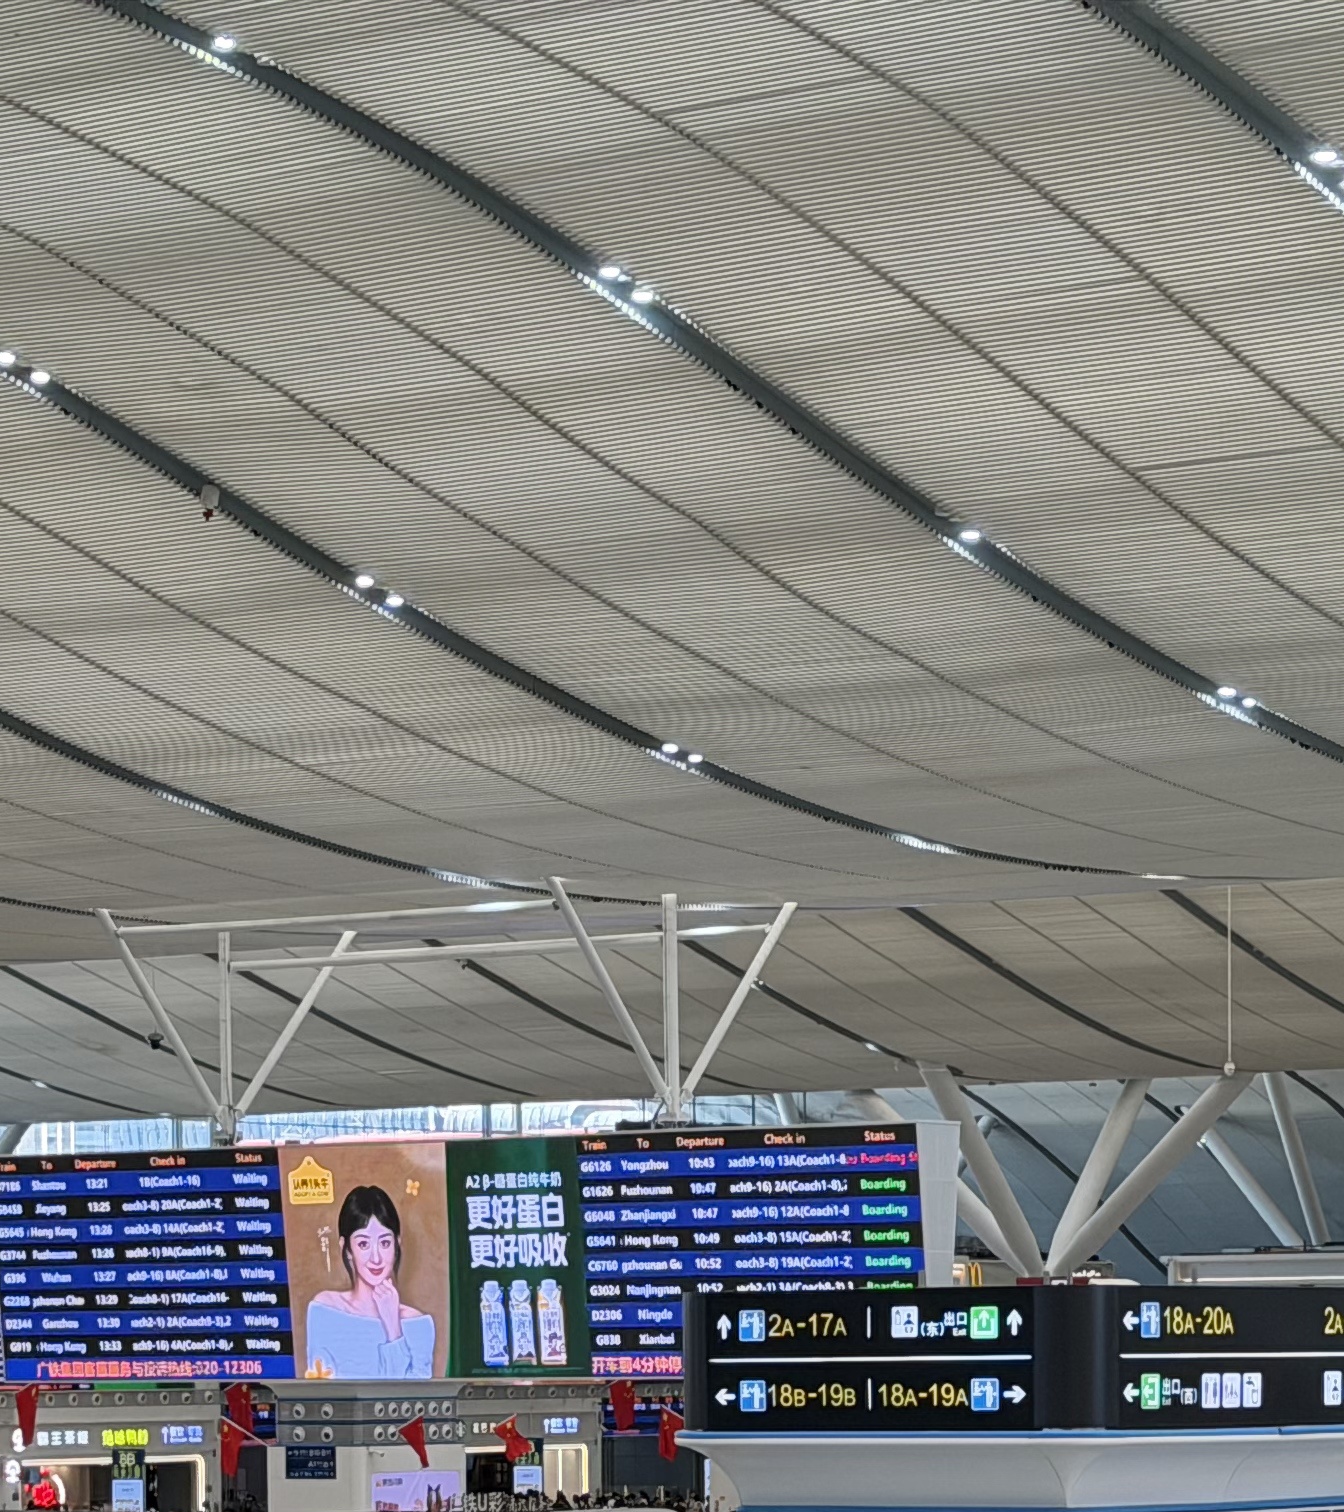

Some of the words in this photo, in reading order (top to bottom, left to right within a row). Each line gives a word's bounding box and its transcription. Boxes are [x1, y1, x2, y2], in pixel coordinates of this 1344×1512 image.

[582, 1140, 607, 1151] Train
[636, 1138, 650, 1149] To
[676, 1137, 725, 1149] Departure
[764, 1134, 794, 1145] Check
[796, 1133, 806, 1144] in
[864, 1131, 896, 1142] Status
[41, 1161, 53, 1170] To
[150, 1156, 175, 1166] Check
[177, 1155, 186, 1165] in
[235, 1153, 262, 1163] Status
[232, 1173, 268, 1187] Waiting
[860, 1177, 906, 1191] Boarding
[235, 1197, 270, 1210] Waiting
[862, 1203, 908, 1217] Boarding
[466, 1192, 565, 1230] 更好蛋白
[236, 1220, 272, 1234] Waiting
[624, 1235, 651, 1248] Hong
[864, 1228, 910, 1243] Boarding
[238, 1243, 273, 1257] Waiting
[469, 1232, 569, 1268] 更好吸收
[865, 1254, 912, 1269] Boarding
[240, 1267, 275, 1281] Waiting
[242, 1291, 277, 1305] Waiting
[244, 1315, 279, 1329] Waiting
[768, 1312, 847, 1338] 2A-17A
[944, 1310, 968, 1327] 出口
[1163, 1305, 1235, 1335] 18A-20A
[246, 1338, 281, 1352] Waiting
[768, 1383, 857, 1407] 18B-19B
[878, 1382, 969, 1407] 18A-19A
